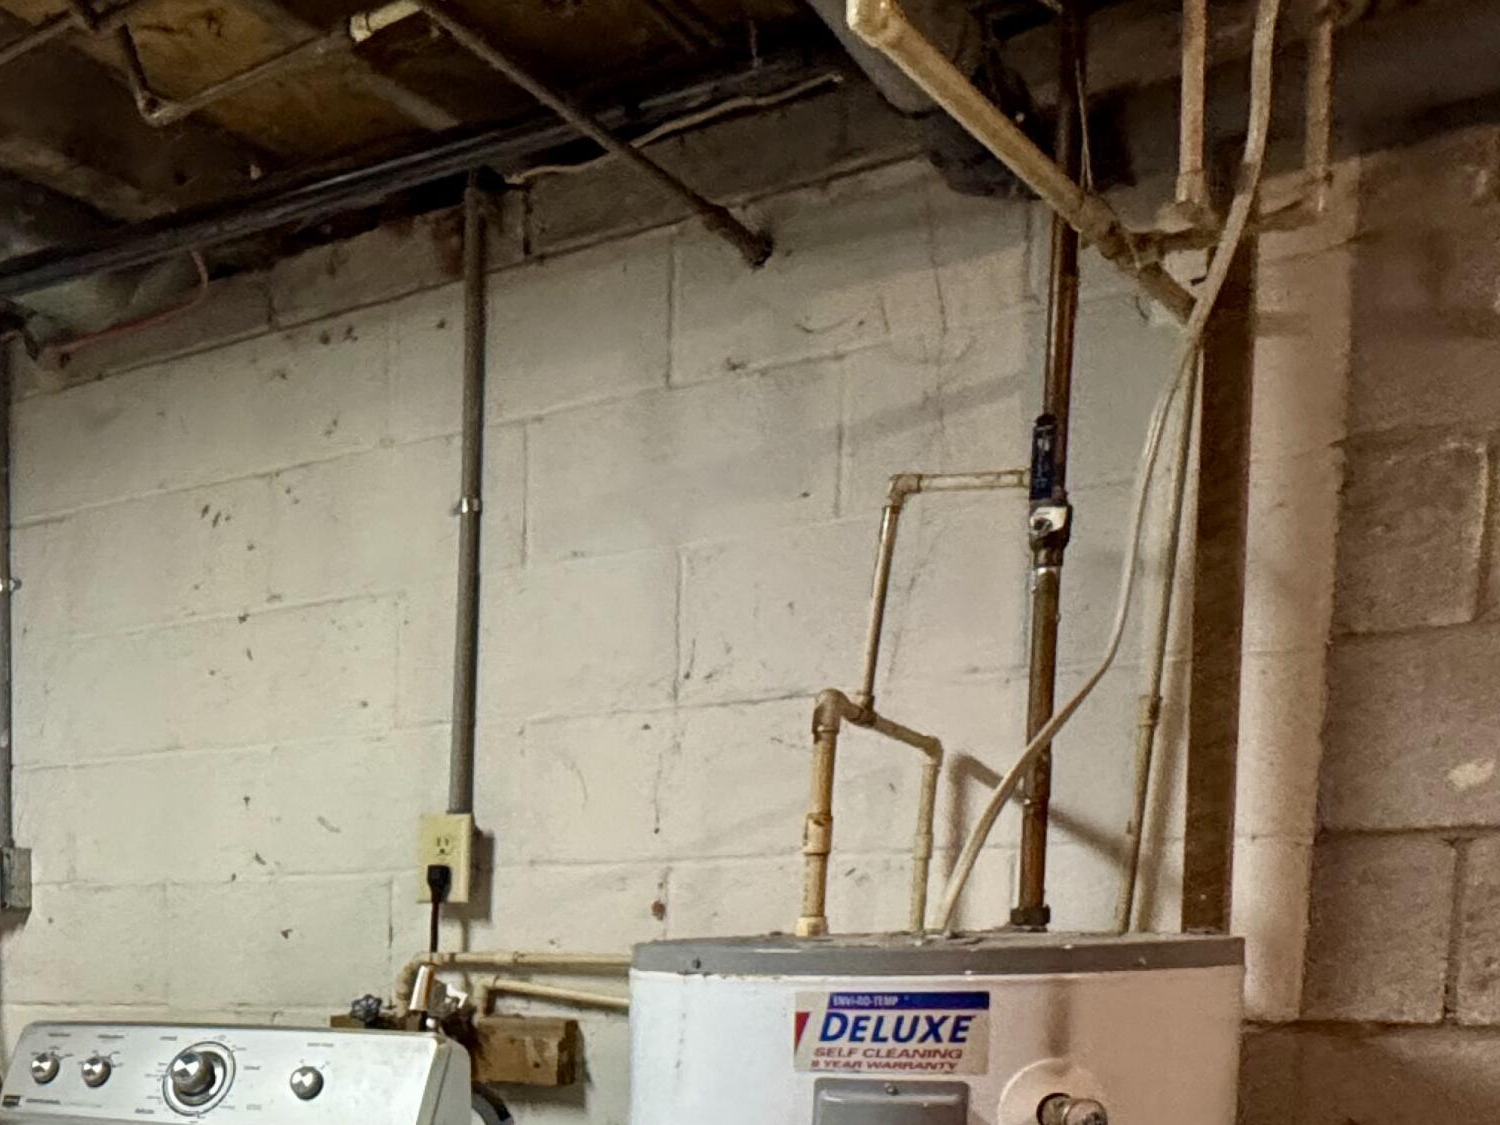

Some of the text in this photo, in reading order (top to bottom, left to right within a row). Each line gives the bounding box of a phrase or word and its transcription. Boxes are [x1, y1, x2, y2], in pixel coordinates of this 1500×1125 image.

[819, 1012, 975, 1043] DELUXE
[814, 1047, 962, 1059] SELF CLEANING
[824, 1060, 862, 1069] YEAR
[867, 1061, 958, 1070] WARRANTY
